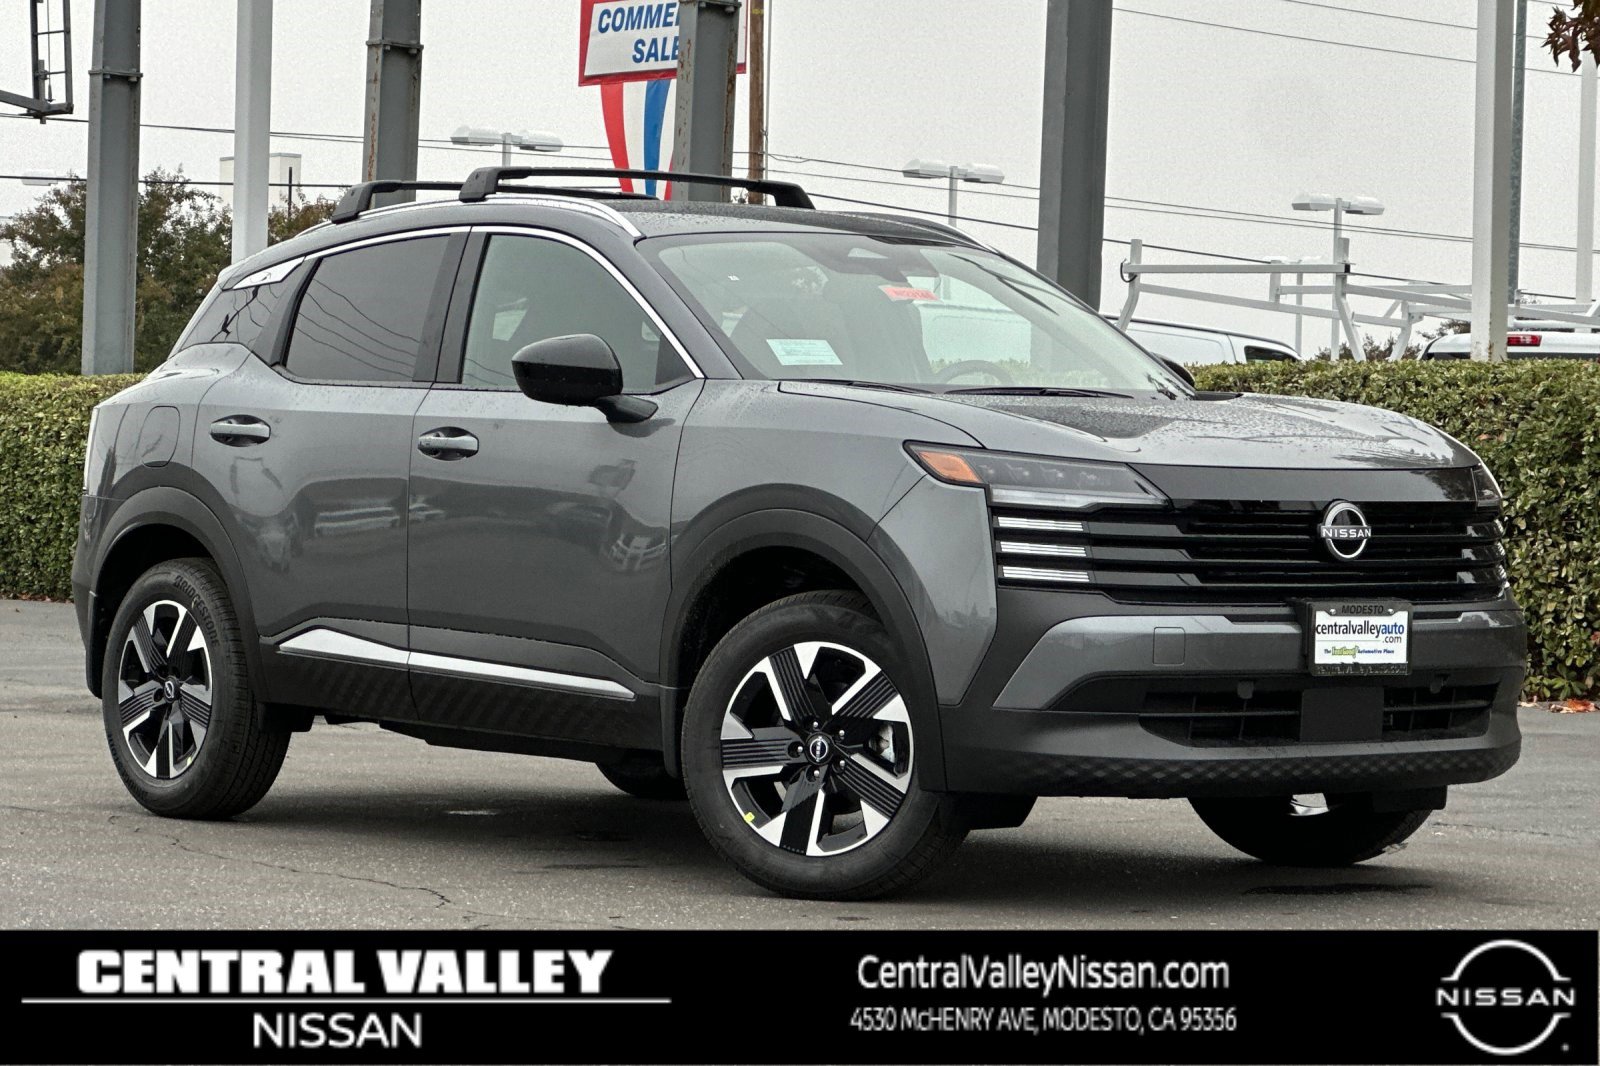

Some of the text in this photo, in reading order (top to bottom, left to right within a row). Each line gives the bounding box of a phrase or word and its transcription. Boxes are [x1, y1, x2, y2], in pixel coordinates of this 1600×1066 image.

[1322, 528, 1372, 538] NISSAN
[174, 575, 221, 647] BRIDGESTONE
[1341, 605, 1384, 615] MODESTO
[1316, 620, 1405, 639] centralvalleyauto
[1382, 635, 1402, 644] .com
